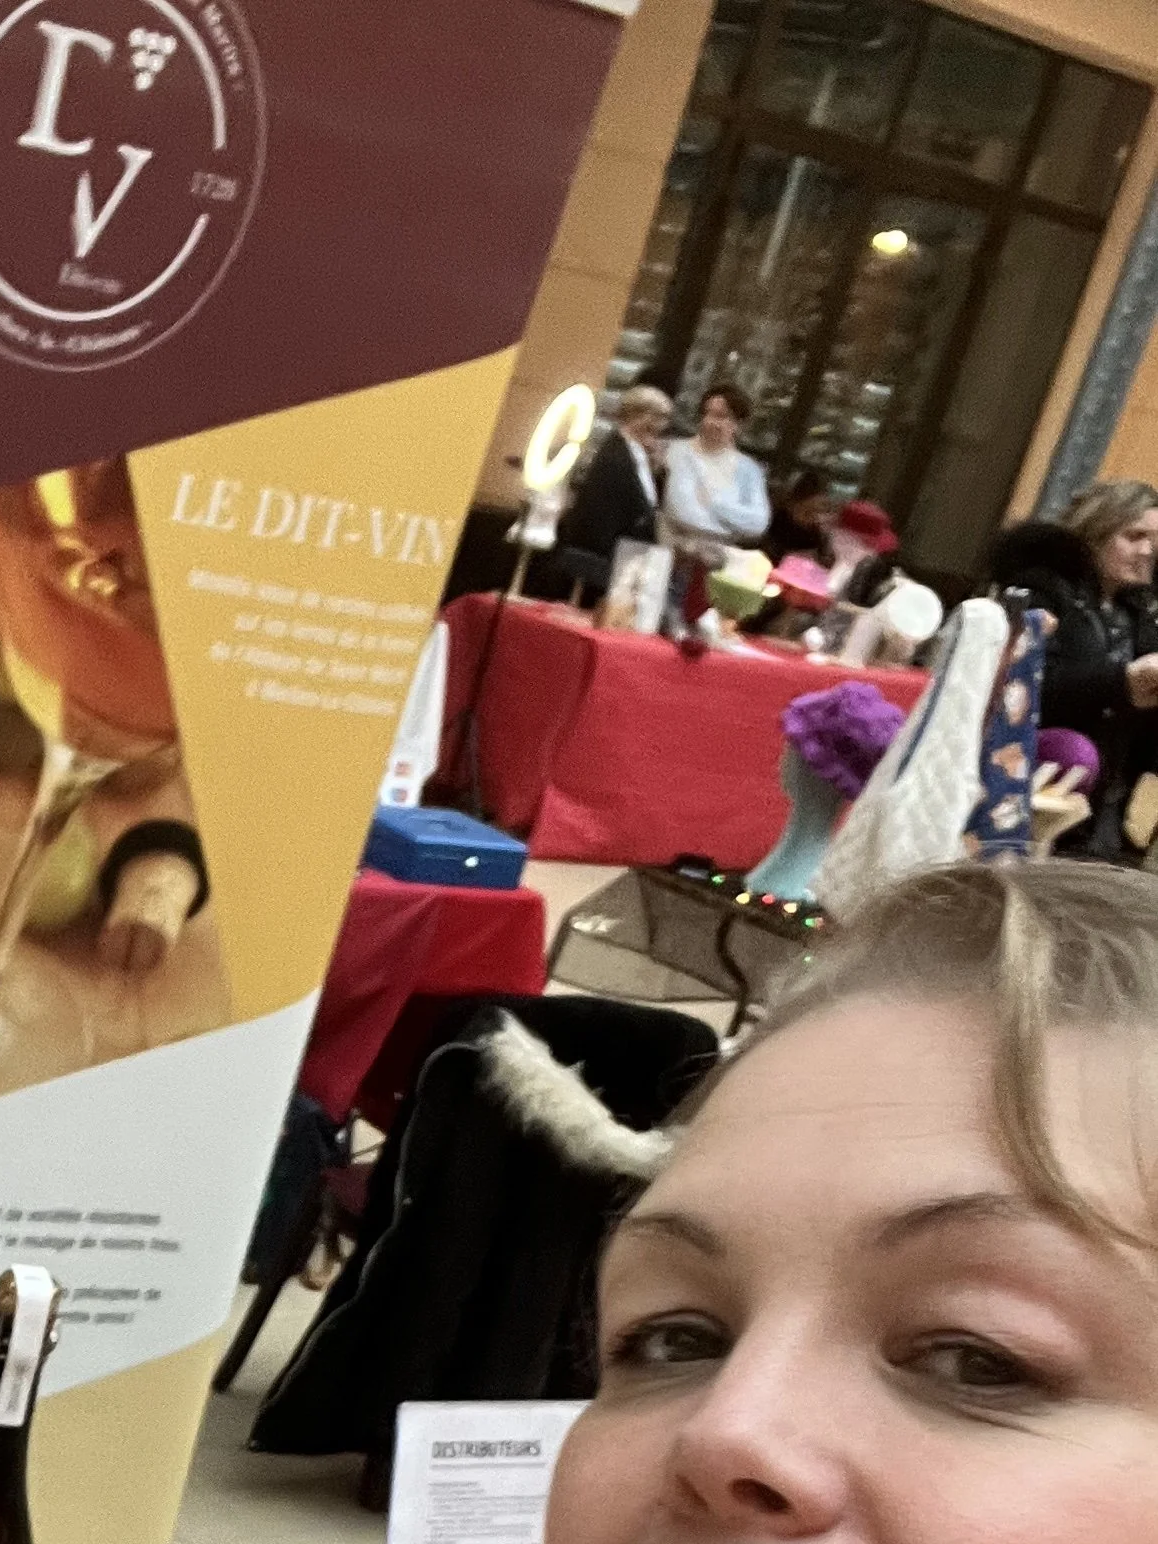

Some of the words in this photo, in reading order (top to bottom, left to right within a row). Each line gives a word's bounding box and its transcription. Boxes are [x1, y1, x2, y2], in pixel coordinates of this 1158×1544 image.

[172, 474, 241, 531] LE
[250, 487, 457, 565] DIT-VIN
[432, 1440, 541, 1459] DISTRIBUTEURS
